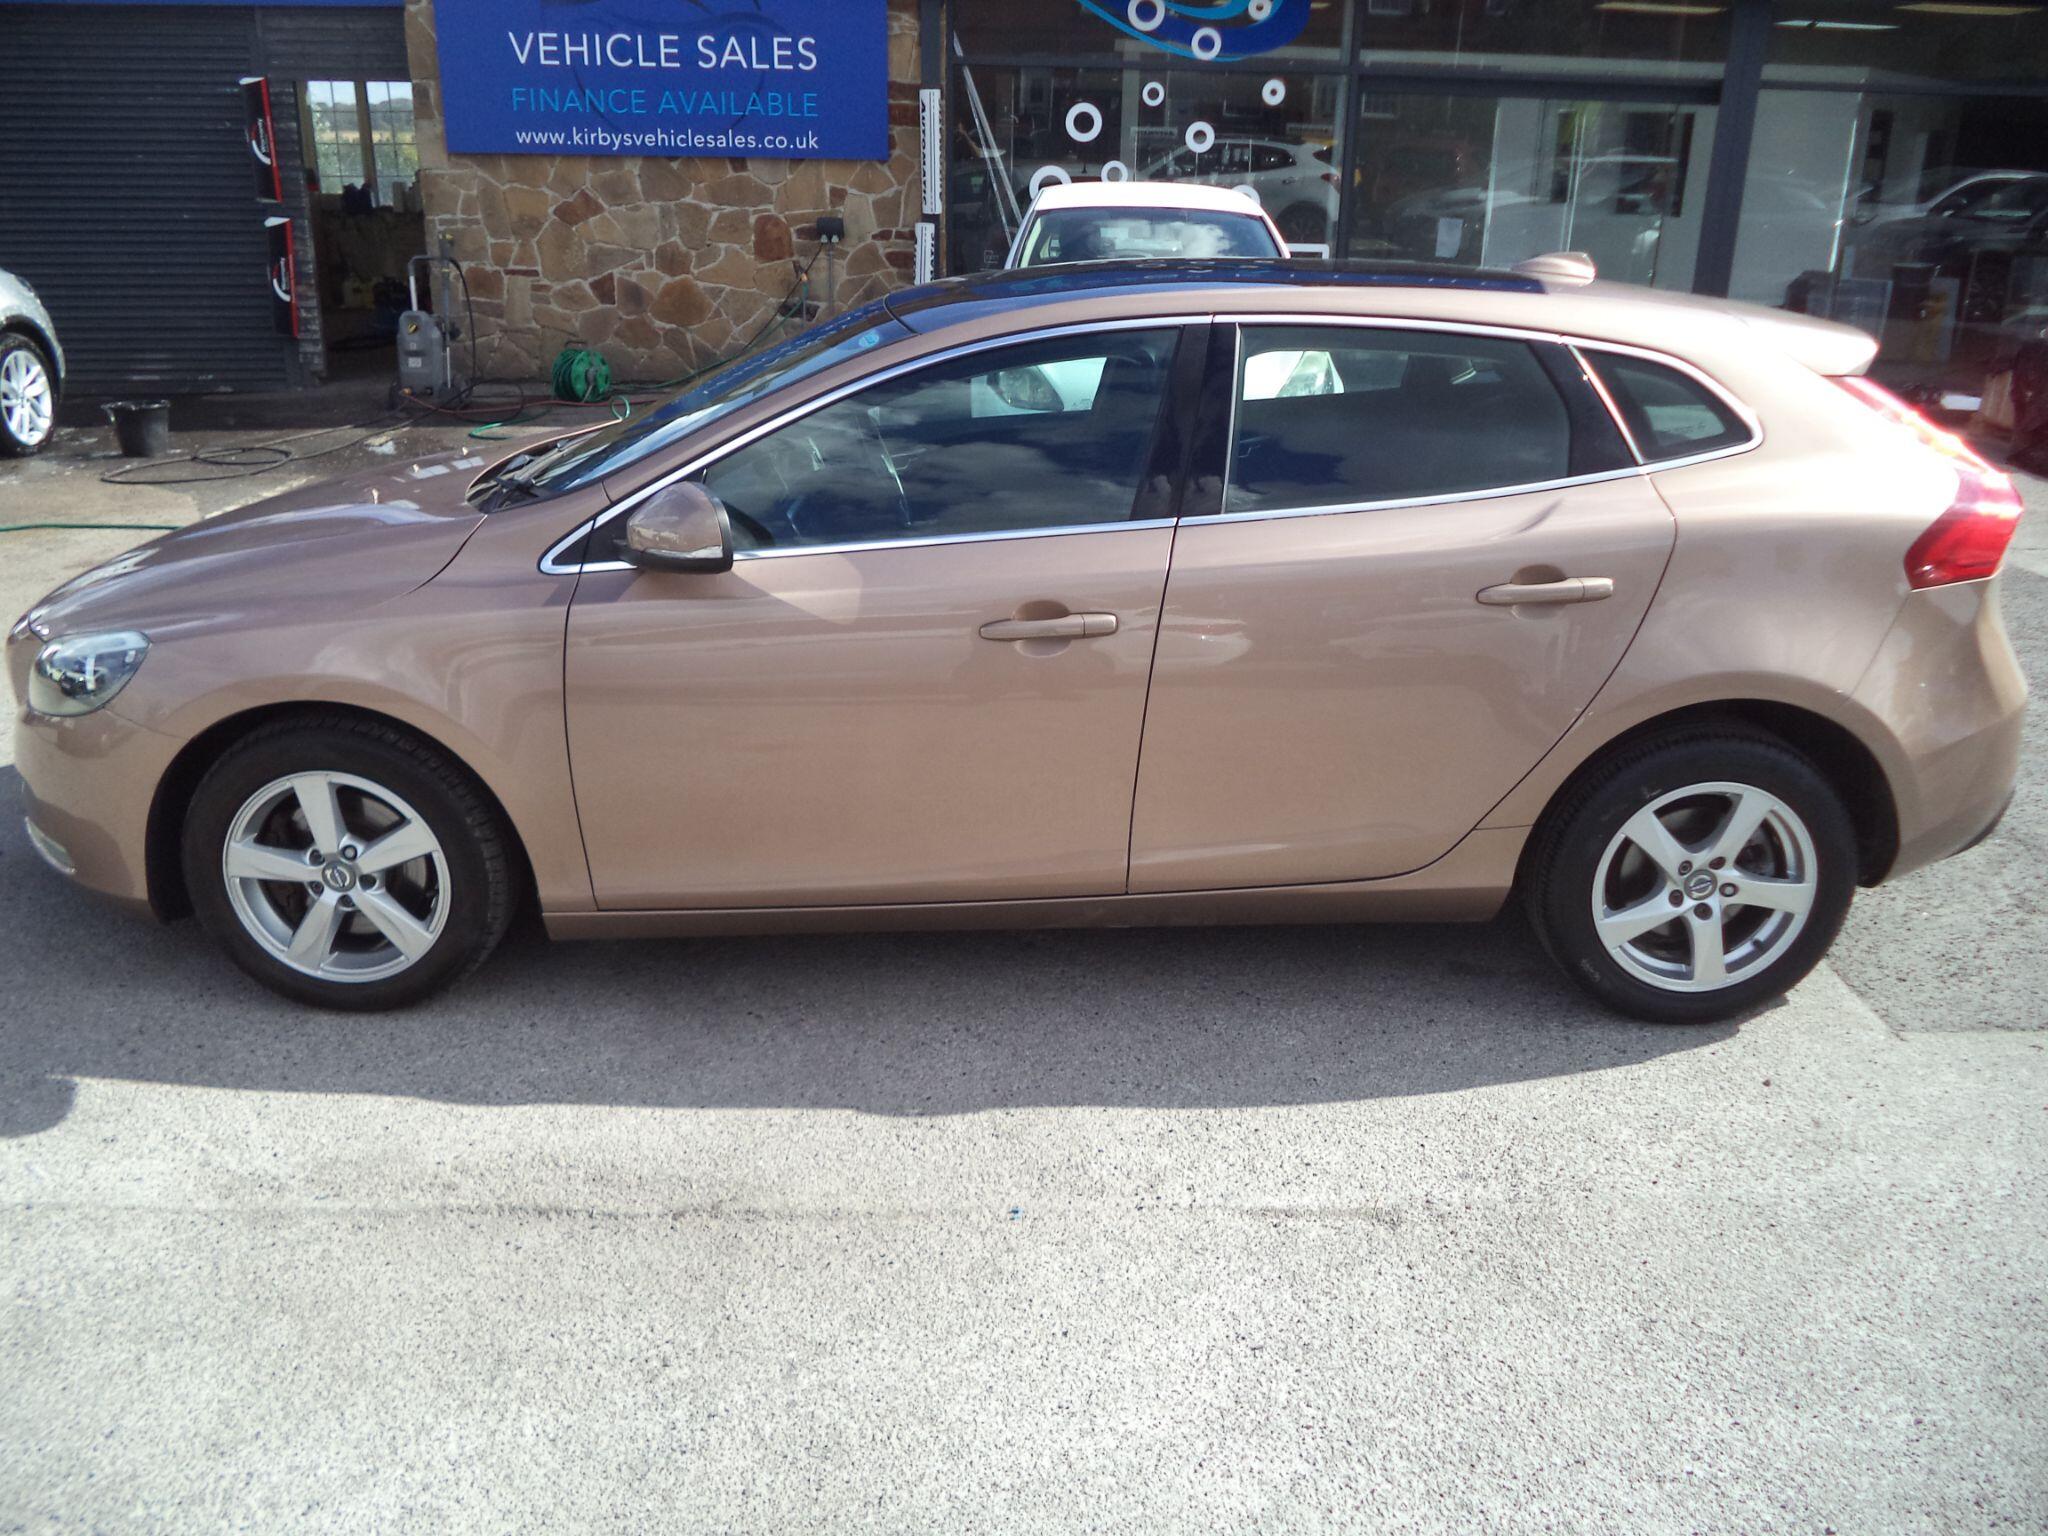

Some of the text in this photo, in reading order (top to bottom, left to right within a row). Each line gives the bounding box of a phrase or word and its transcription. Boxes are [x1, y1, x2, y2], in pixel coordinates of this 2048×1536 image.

[508, 31, 817, 71] VEHICLE SALES
[511, 87, 819, 117] FINANCE AVAILABLE
[515, 126, 819, 151] www.kirbysvehiclesales.co.uk
